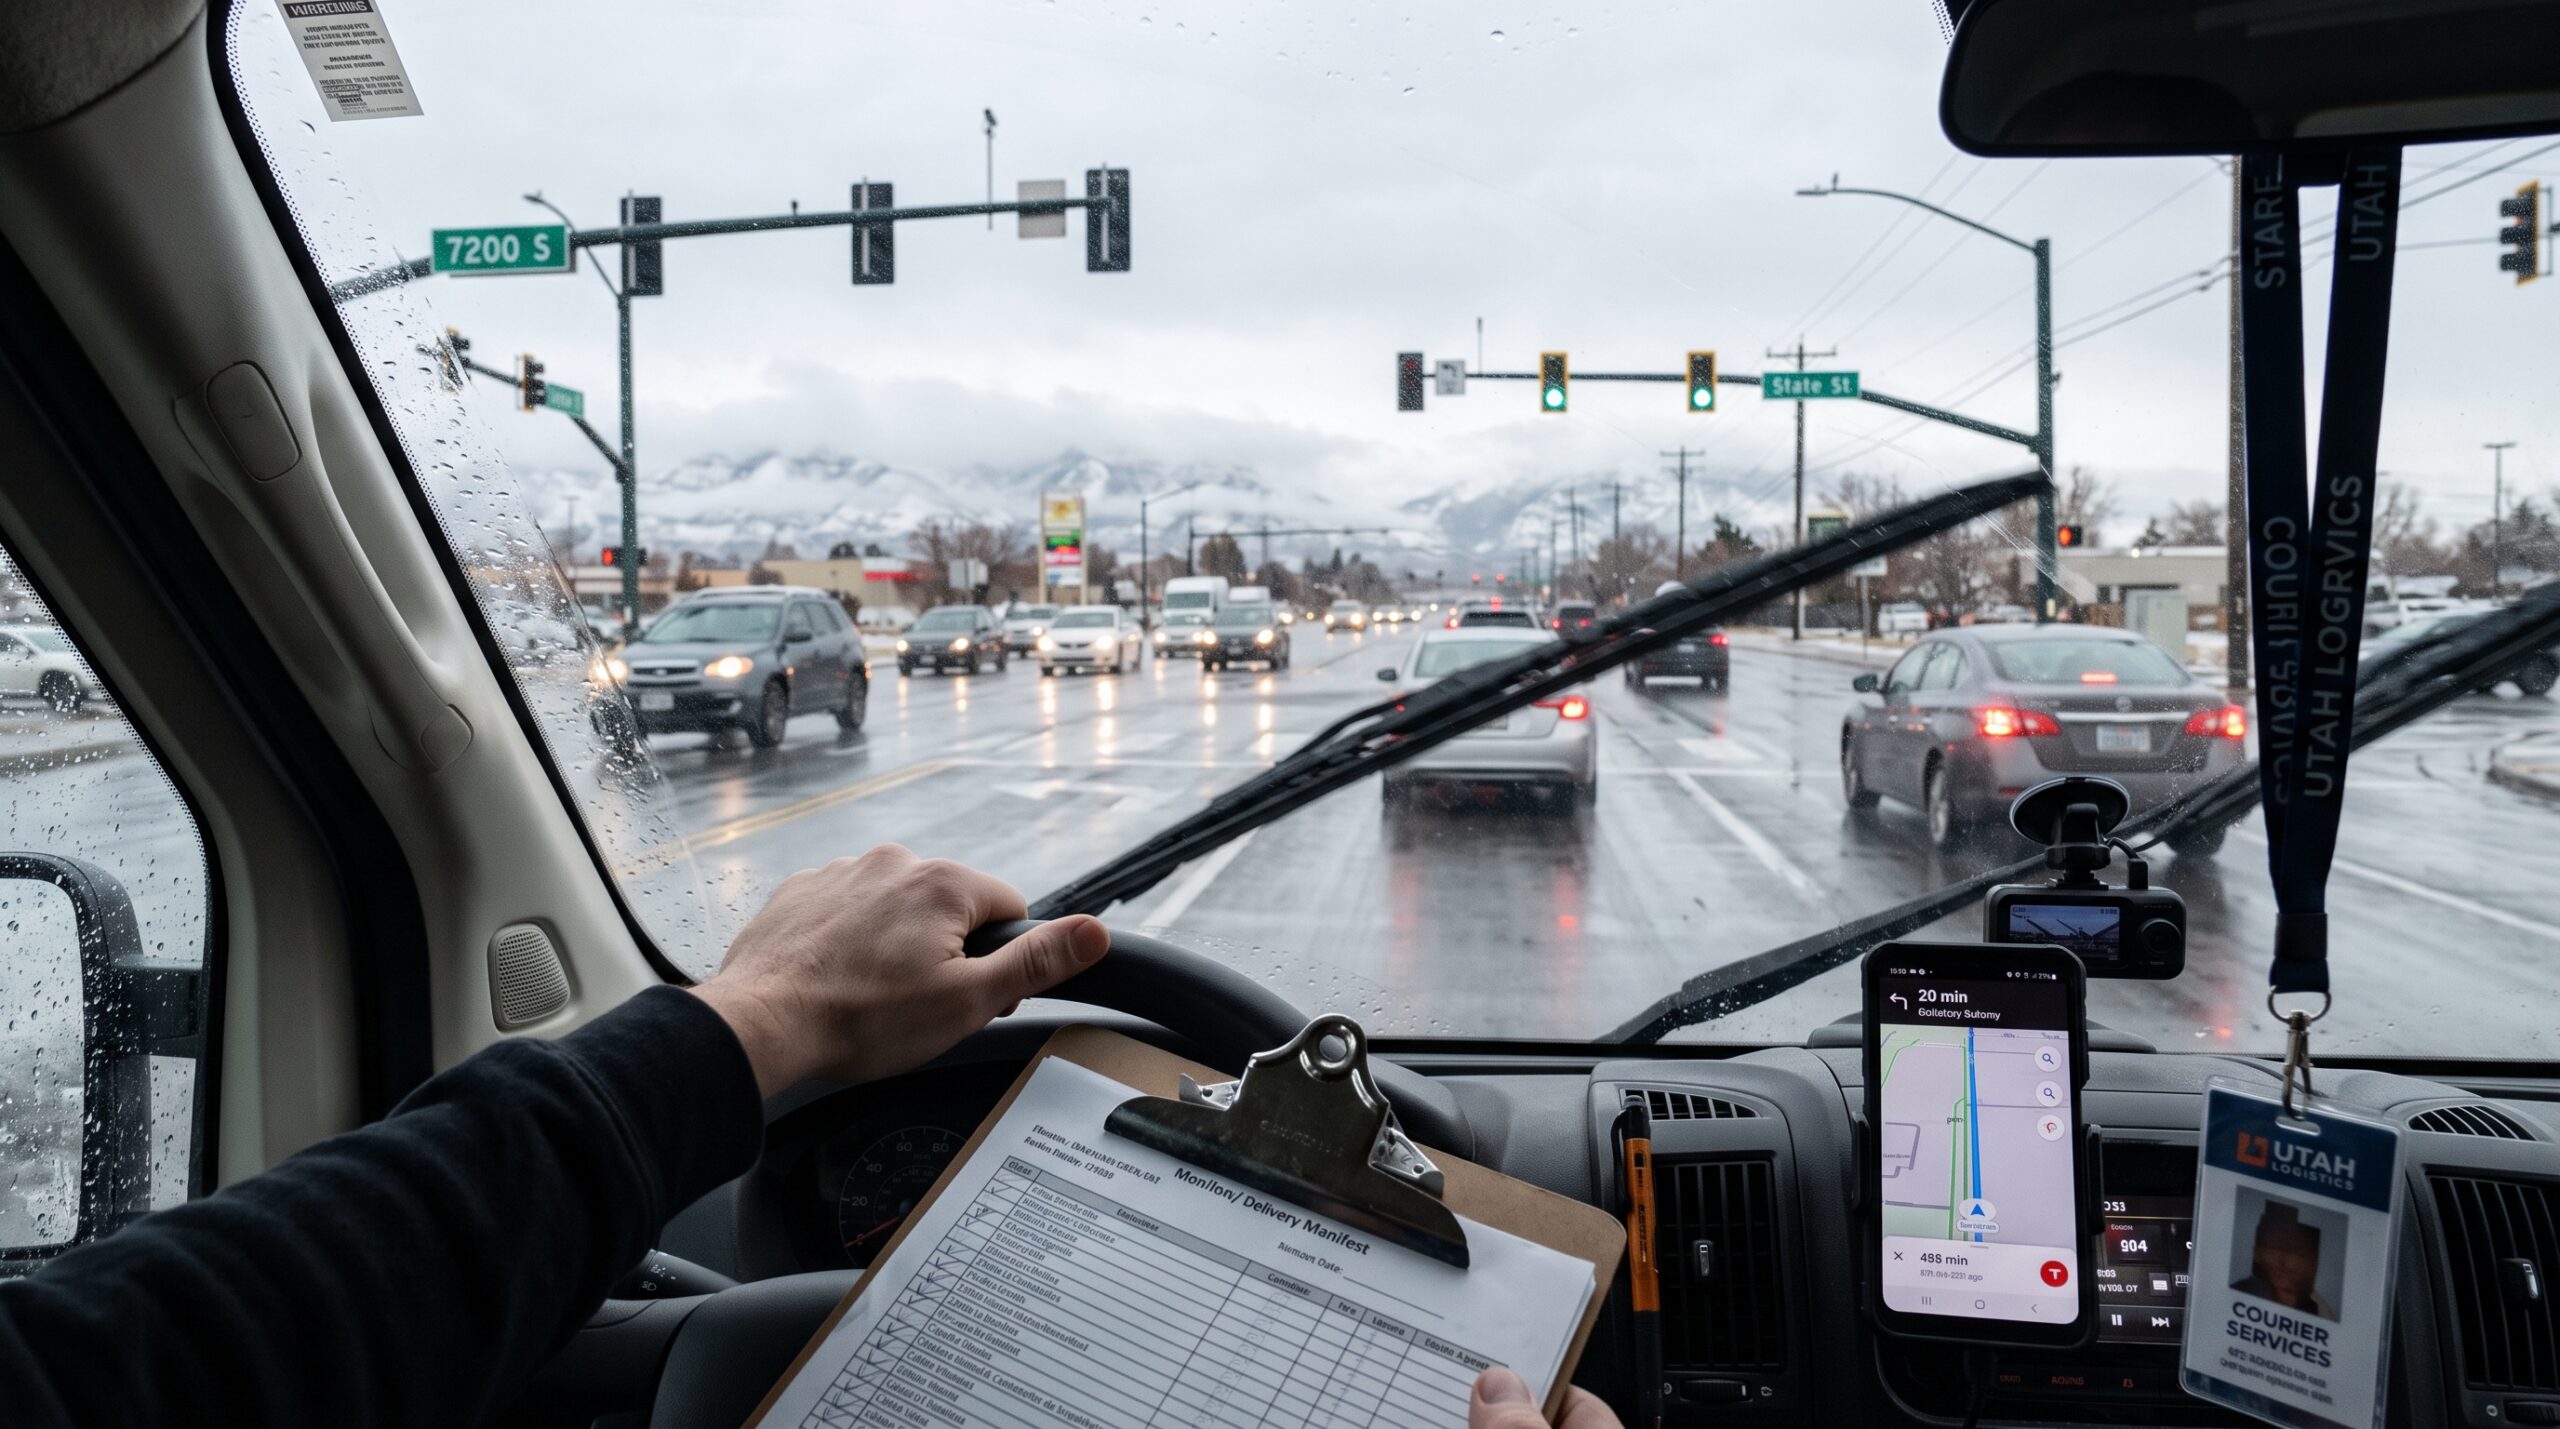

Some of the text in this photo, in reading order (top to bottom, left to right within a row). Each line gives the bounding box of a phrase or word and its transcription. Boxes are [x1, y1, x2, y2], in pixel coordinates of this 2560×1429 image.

[2350, 164, 2387, 261] UTAH
[2254, 175, 2285, 289] STARE
[446, 232, 551, 264] 7200 S
[1772, 376, 1851, 395] State St
[2304, 475, 2363, 797] UTAH LOGRVICS
[1918, 989, 1968, 1003] 20 min
[896, 1142, 949, 1153] 60 80
[2272, 1140, 2356, 1179] UTAH
[866, 1163, 882, 1173] 40
[2271, 1161, 2355, 1191] LOGISTICS
[852, 1196, 868, 1206] 20
[1242, 1195, 1301, 1228] Delivery
[1303, 1219, 1371, 1255] Manifest
[1317, 1257, 1343, 1275] Date:
[1945, 1254, 1968, 1266] min
[1968, 1274, 1983, 1283] ago
[2232, 1301, 2329, 1346] COURIER
[2226, 1320, 2332, 1368] SERVICES
